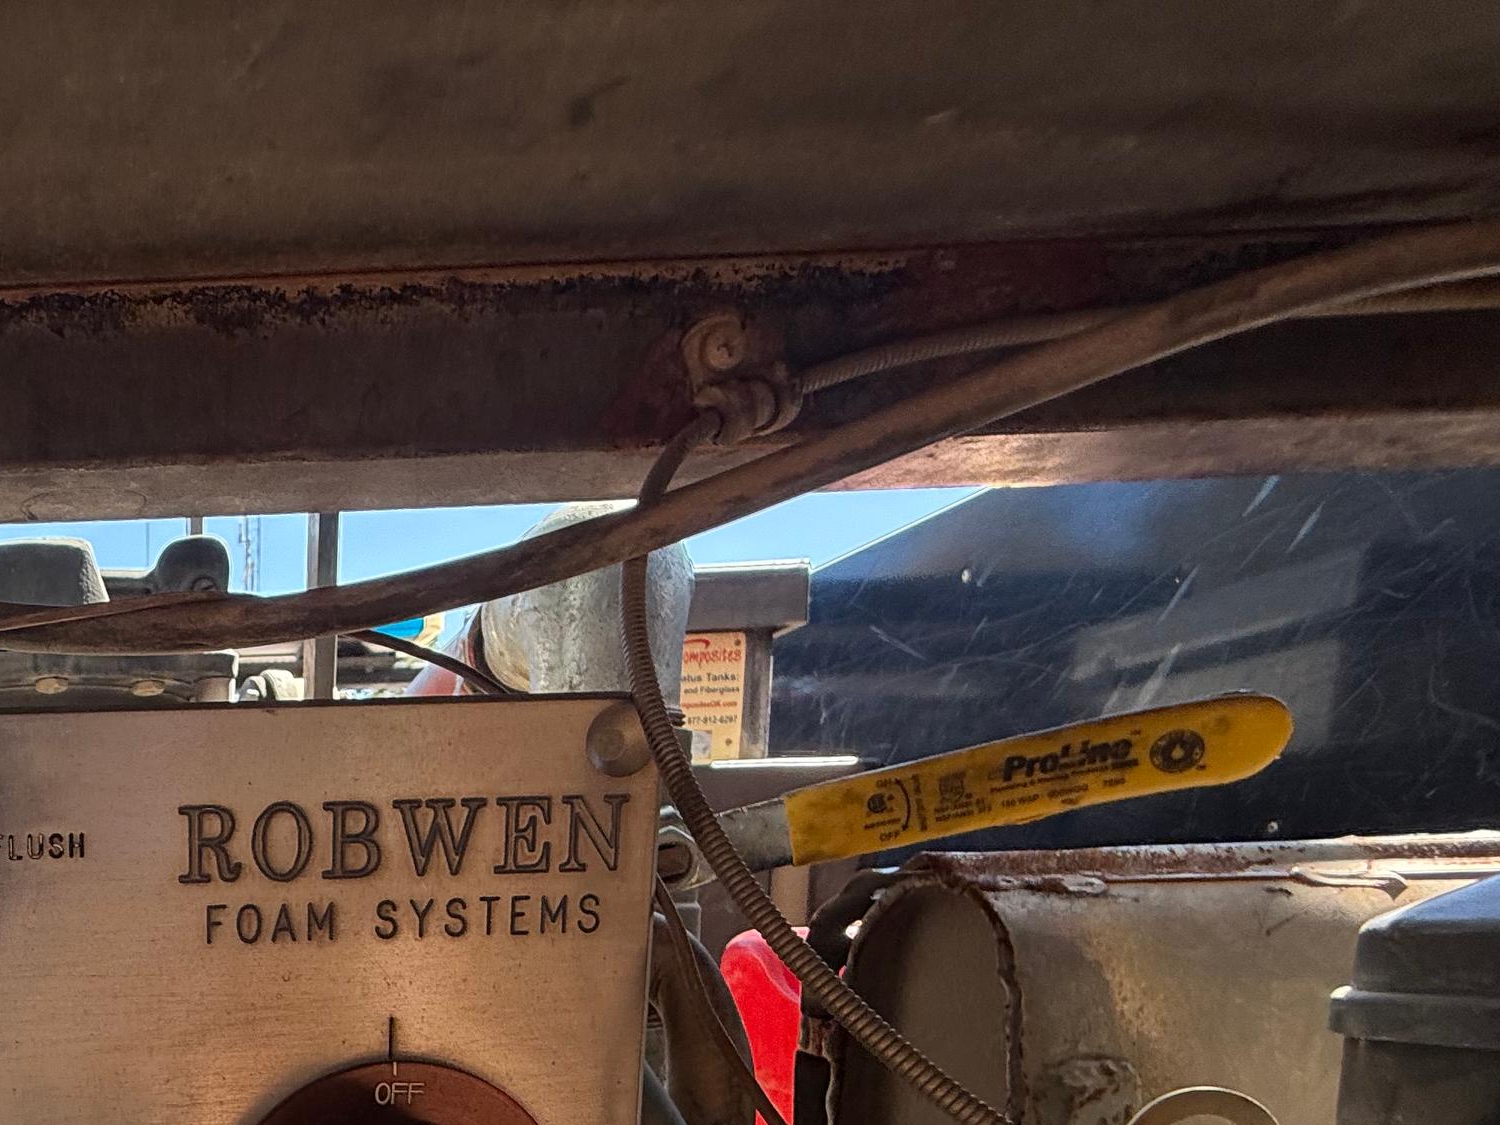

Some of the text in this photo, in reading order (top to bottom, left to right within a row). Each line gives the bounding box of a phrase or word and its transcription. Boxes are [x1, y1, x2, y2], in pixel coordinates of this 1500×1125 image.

[1003, 738, 1133, 782] ProLine
[178, 794, 631, 884] ROBWEN
[206, 893, 601, 944] FOAM SYSTEMS
[375, 1082, 425, 1105] OFF
